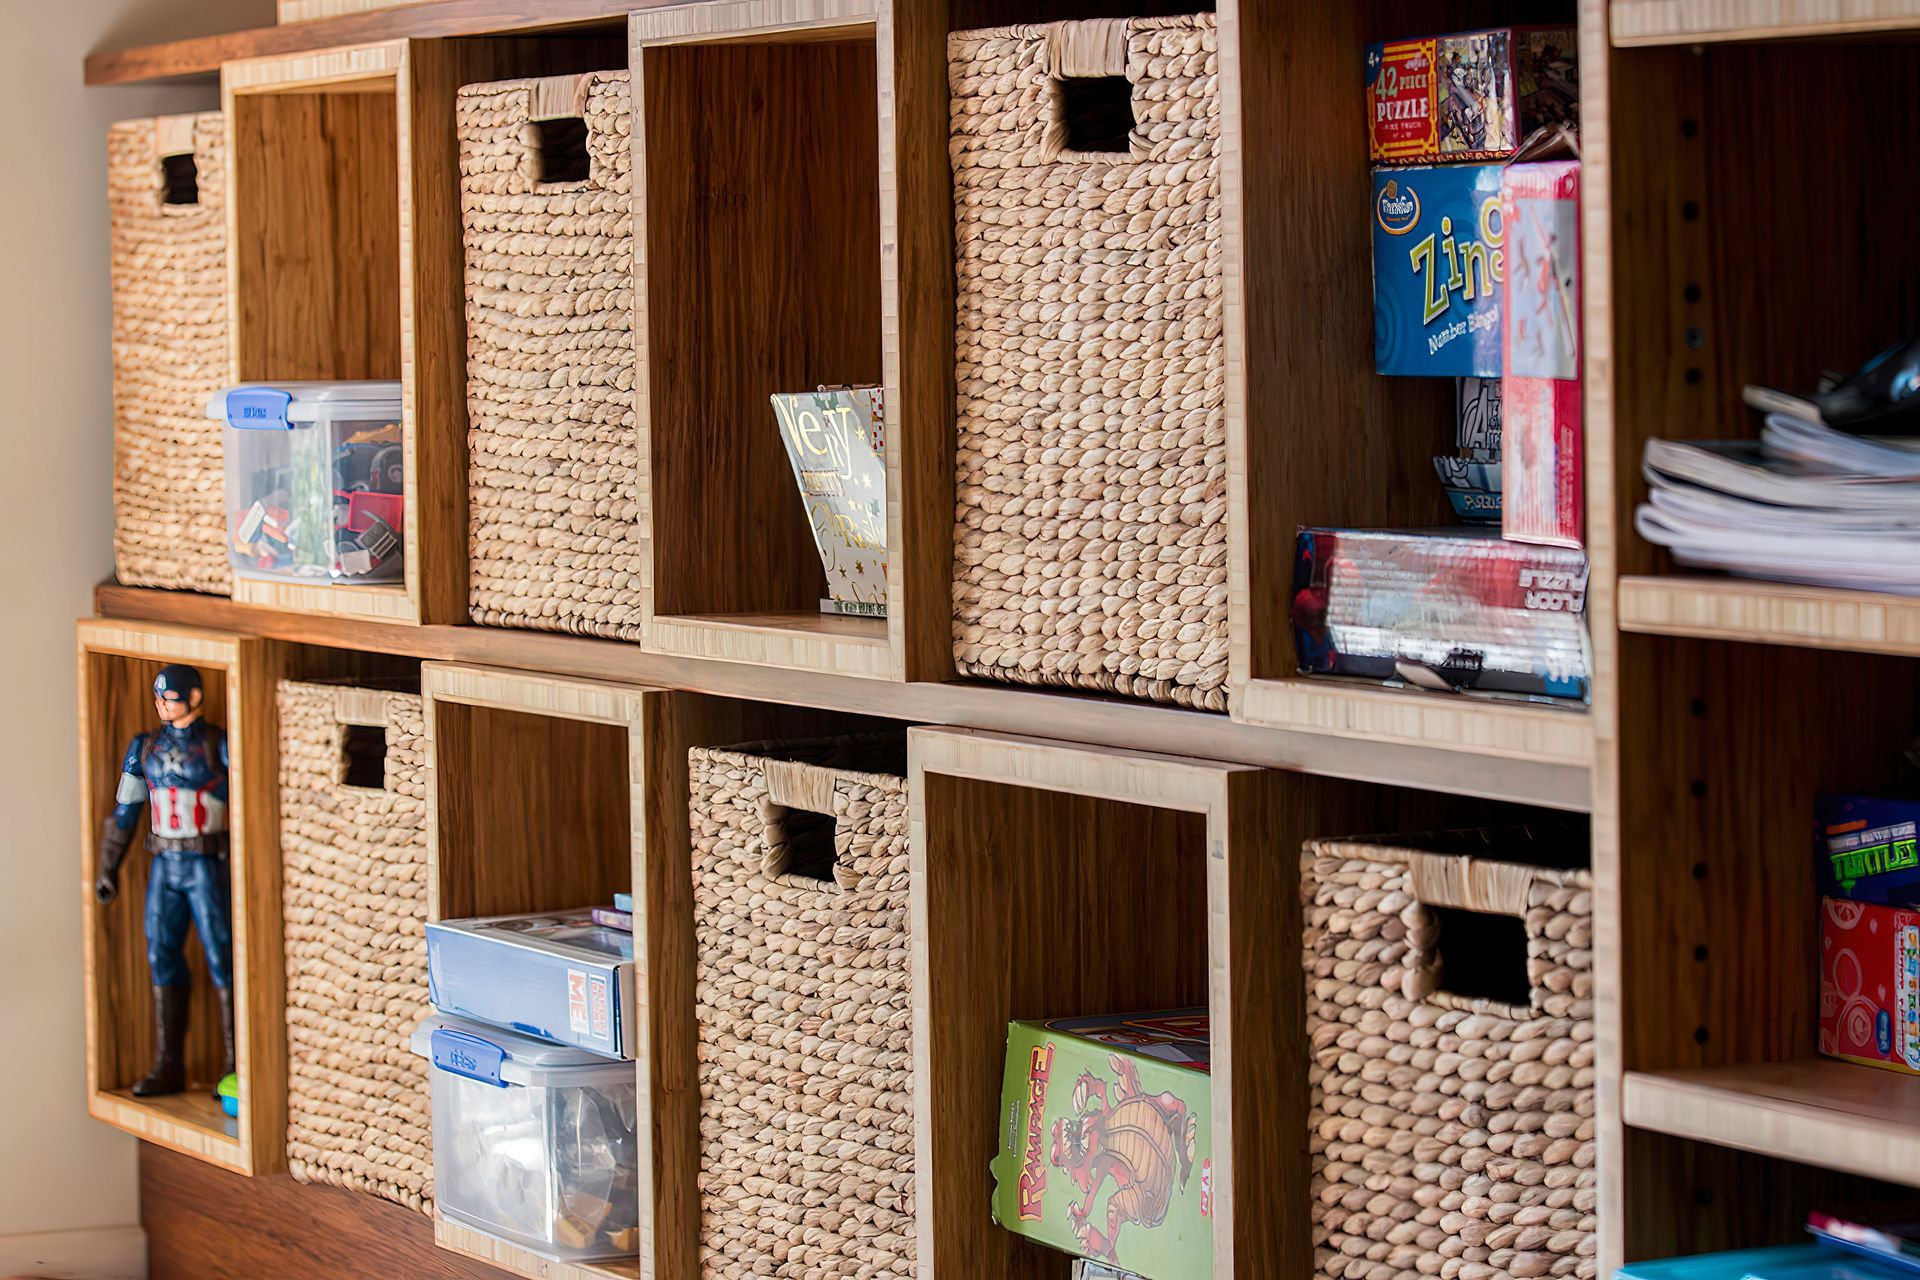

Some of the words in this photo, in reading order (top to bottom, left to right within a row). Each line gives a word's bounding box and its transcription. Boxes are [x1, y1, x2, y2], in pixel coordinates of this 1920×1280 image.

[1375, 65, 1398, 100] 42
[1376, 96, 1430, 123] PUZZLE
[1427, 320, 1467, 356] Number
[1018, 1041, 1057, 1222] RAMPAGE
